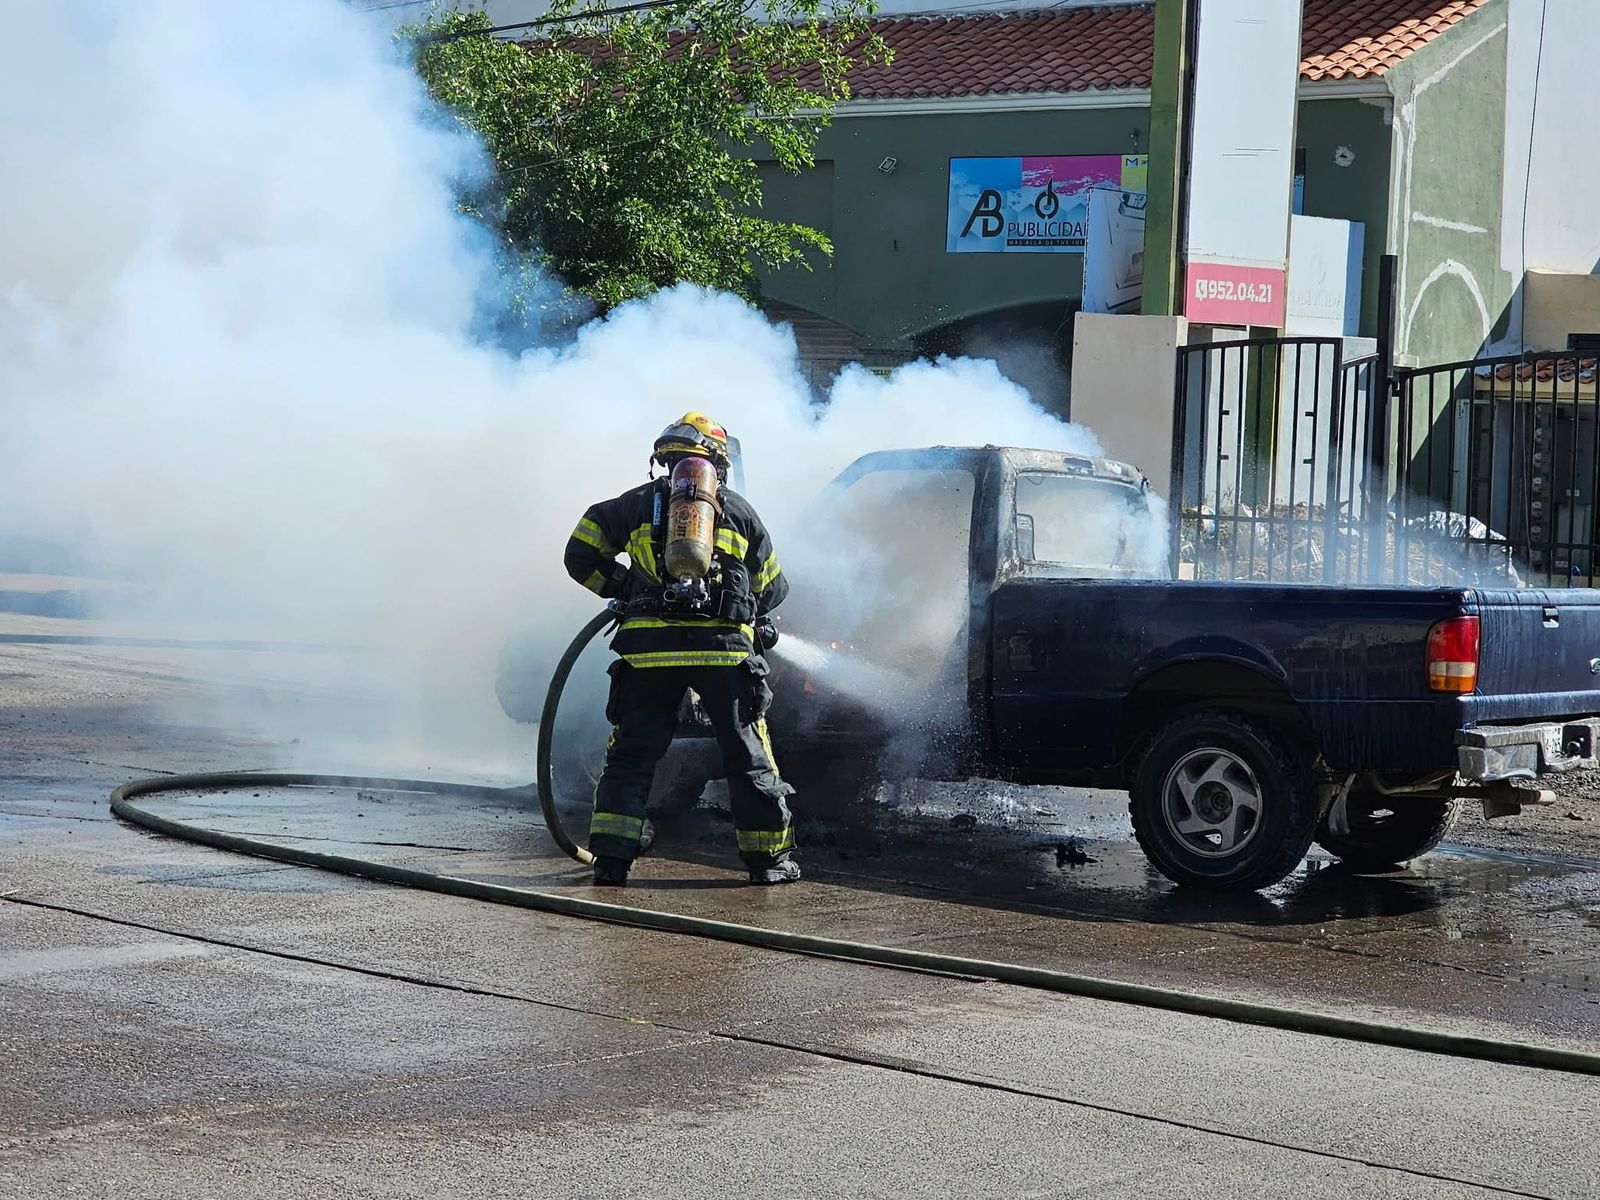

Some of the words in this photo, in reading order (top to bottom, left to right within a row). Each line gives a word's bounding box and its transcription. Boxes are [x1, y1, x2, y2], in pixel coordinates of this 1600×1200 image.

[960, 189, 1005, 238] AB
[1008, 221, 1087, 238] PUBLICIDA
[1208, 280, 1272, 303] 952.04.21
